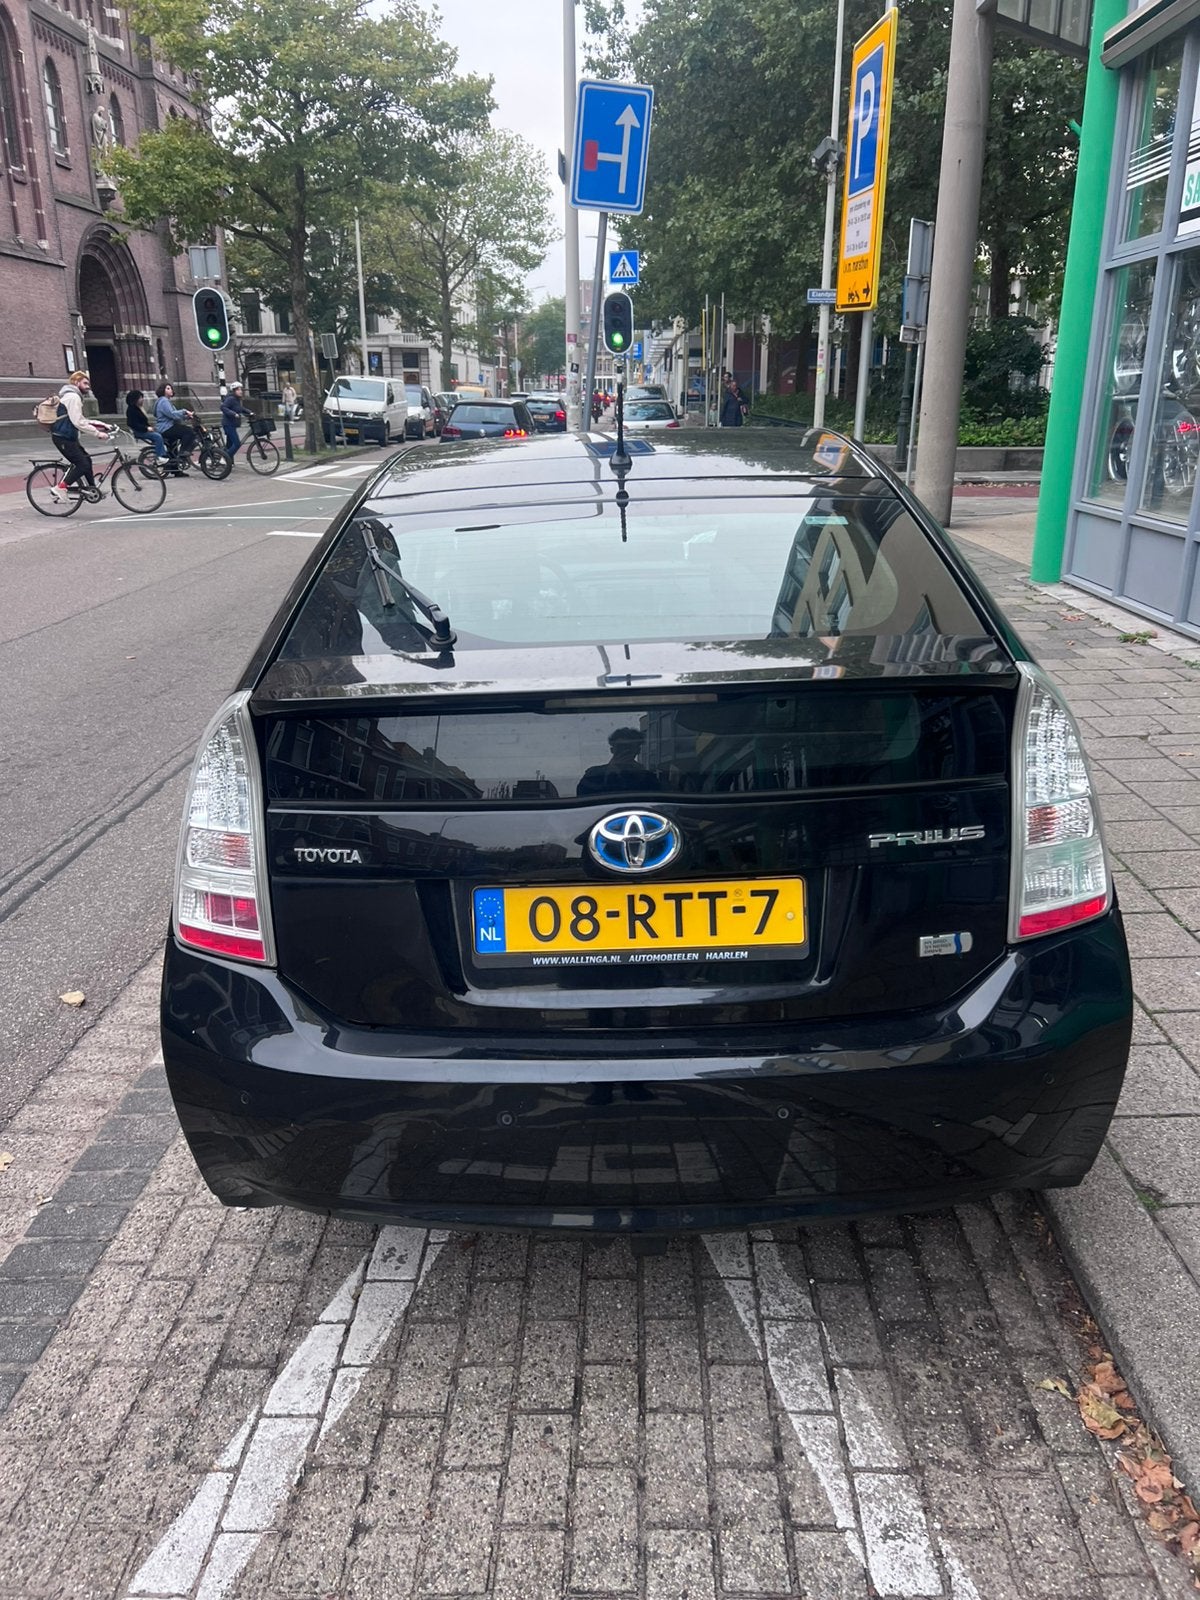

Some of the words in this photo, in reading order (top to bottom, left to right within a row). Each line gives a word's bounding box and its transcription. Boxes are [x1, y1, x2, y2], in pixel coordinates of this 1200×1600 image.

[854, 71, 875, 180] P
[868, 824, 986, 849] PRIUS
[293, 847, 362, 864] TOYOTA
[528, 889, 780, 943] 08-RTT-7
[480, 926, 501, 942] NL
[532, 955, 622, 966] WWW.WALLINGA.NL
[628, 952, 700, 963] AUTOMOBIELEN
[705, 950, 749, 961] HAARLEM
